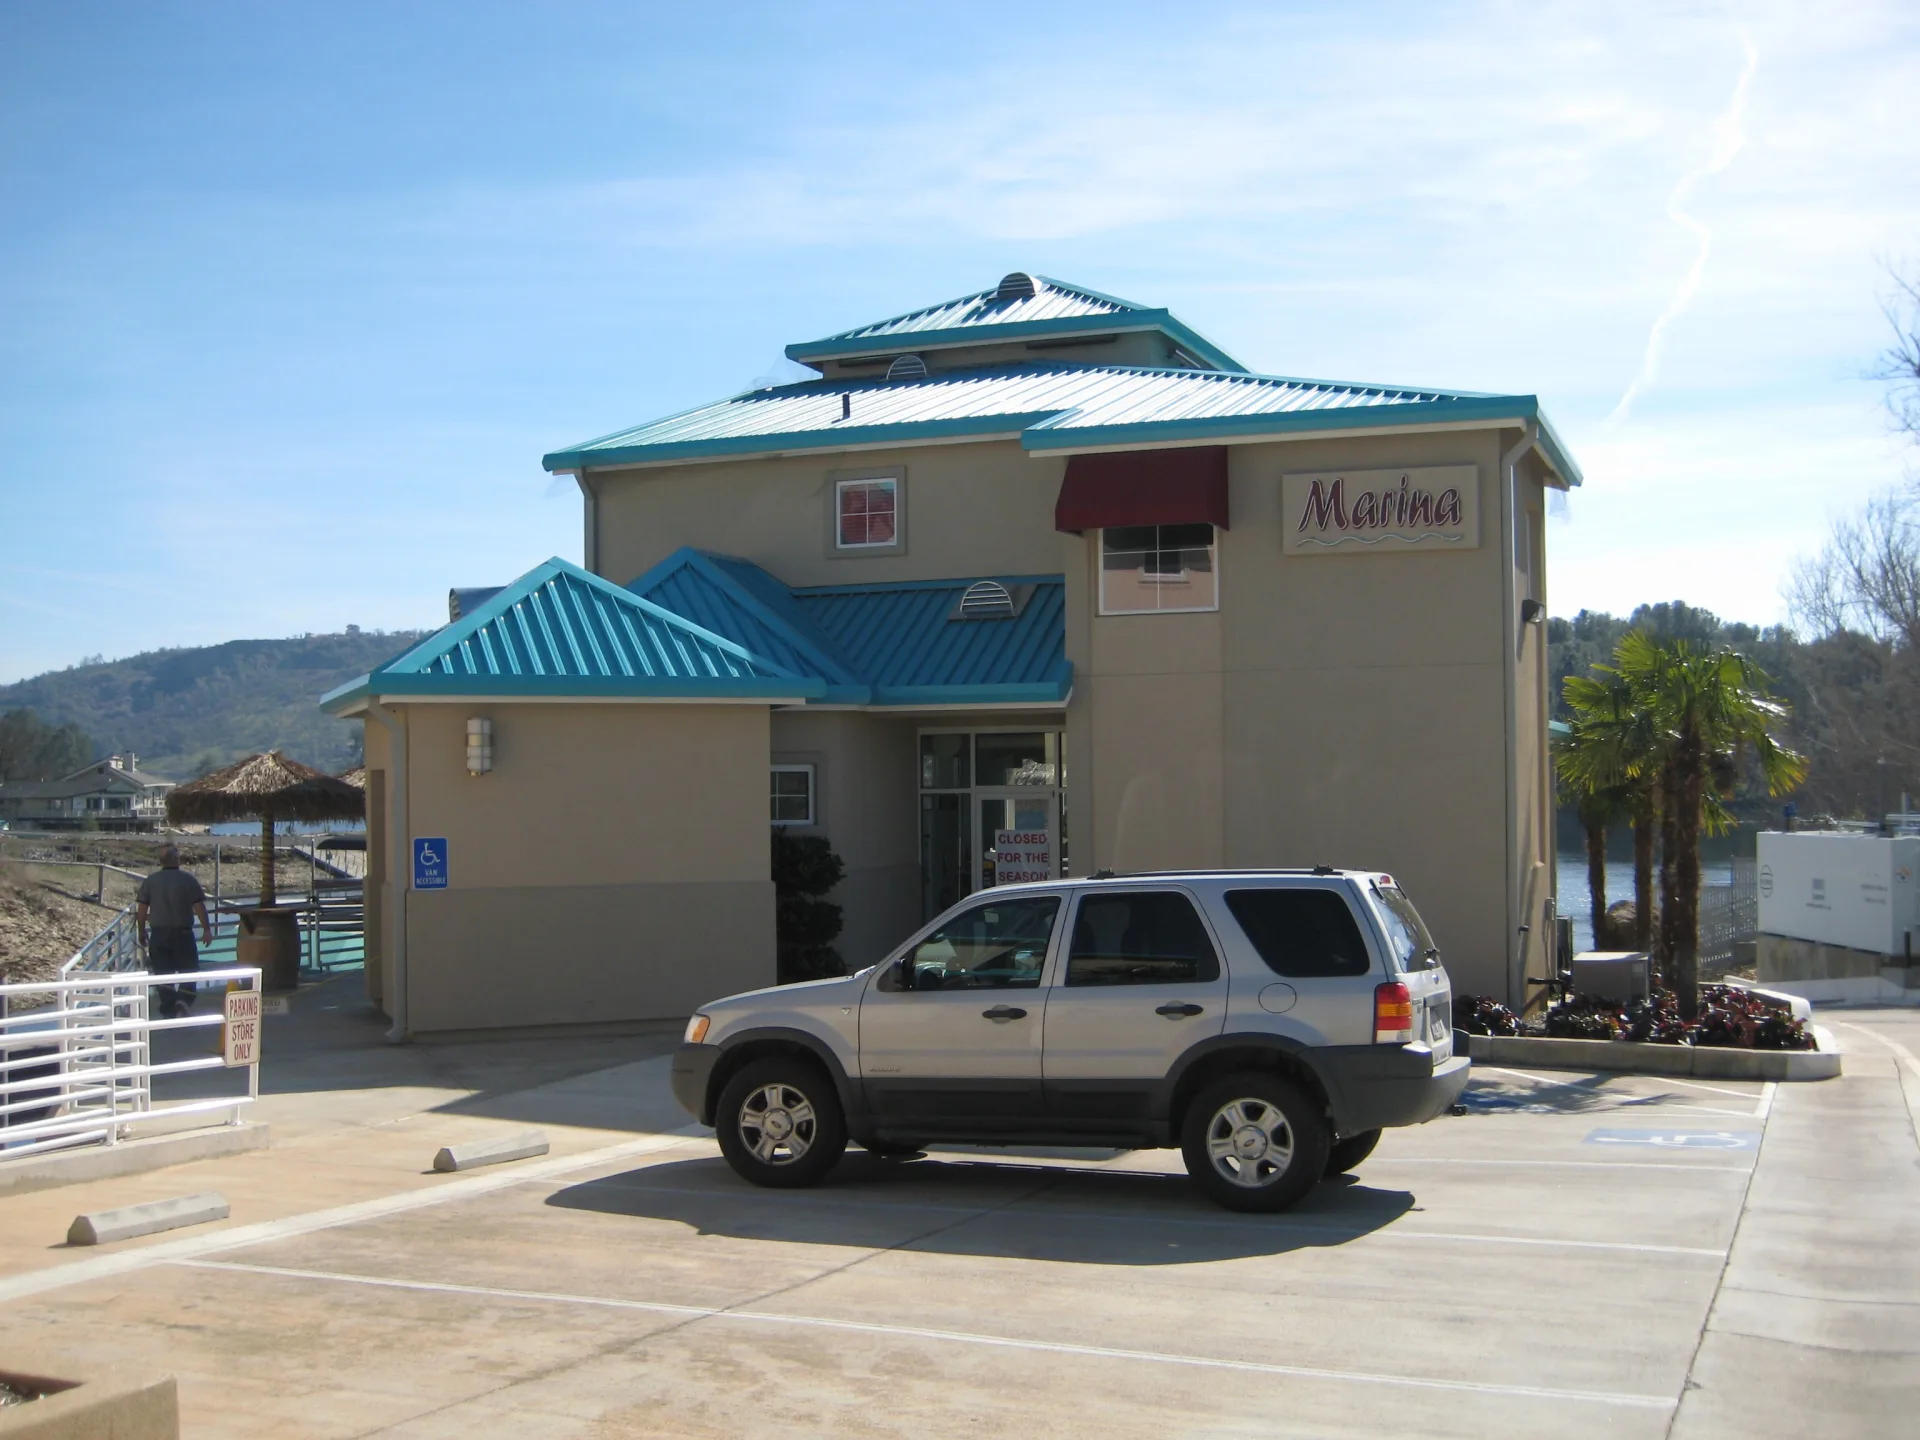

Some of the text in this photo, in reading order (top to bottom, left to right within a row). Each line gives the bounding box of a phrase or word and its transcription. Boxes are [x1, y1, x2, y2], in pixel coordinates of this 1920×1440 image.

[1297, 474, 1462, 532] Marina
[998, 833, 1048, 845] CLOSED
[997, 852, 1049, 863] FOR THE
[998, 871, 1048, 882] SEASON
[229, 997, 258, 1018] PARKING
[232, 1023, 254, 1042] STORE
[234, 1043, 252, 1061] ONLY
